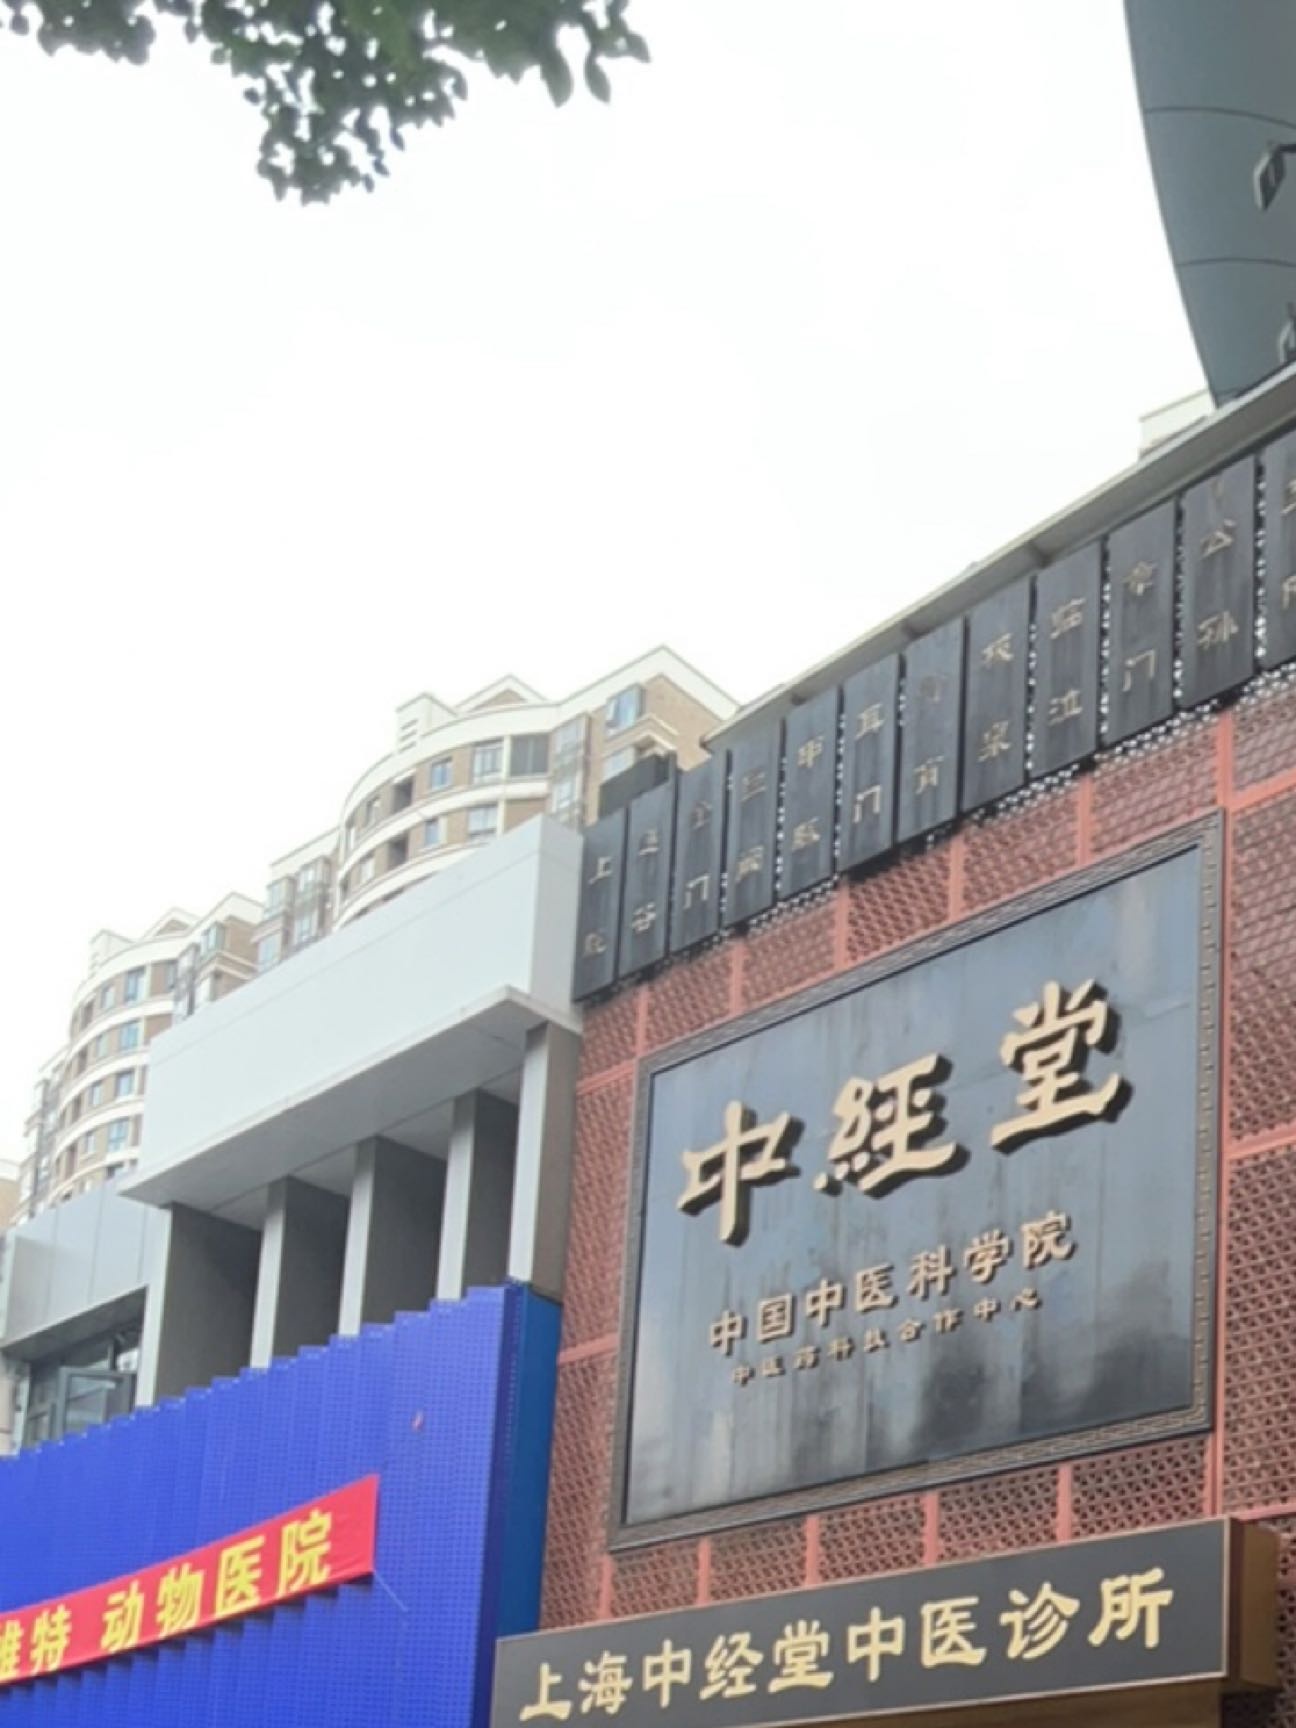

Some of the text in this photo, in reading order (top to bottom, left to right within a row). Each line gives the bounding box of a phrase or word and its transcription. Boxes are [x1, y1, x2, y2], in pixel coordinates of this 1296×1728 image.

[1199, 517, 1241, 651] 公孙
[709, 1211, 1076, 1355] 中国中医科学院
[100, 1509, 332, 1653] 动物医院
[519, 1567, 1174, 1722] 上海中经堂中医诊所
